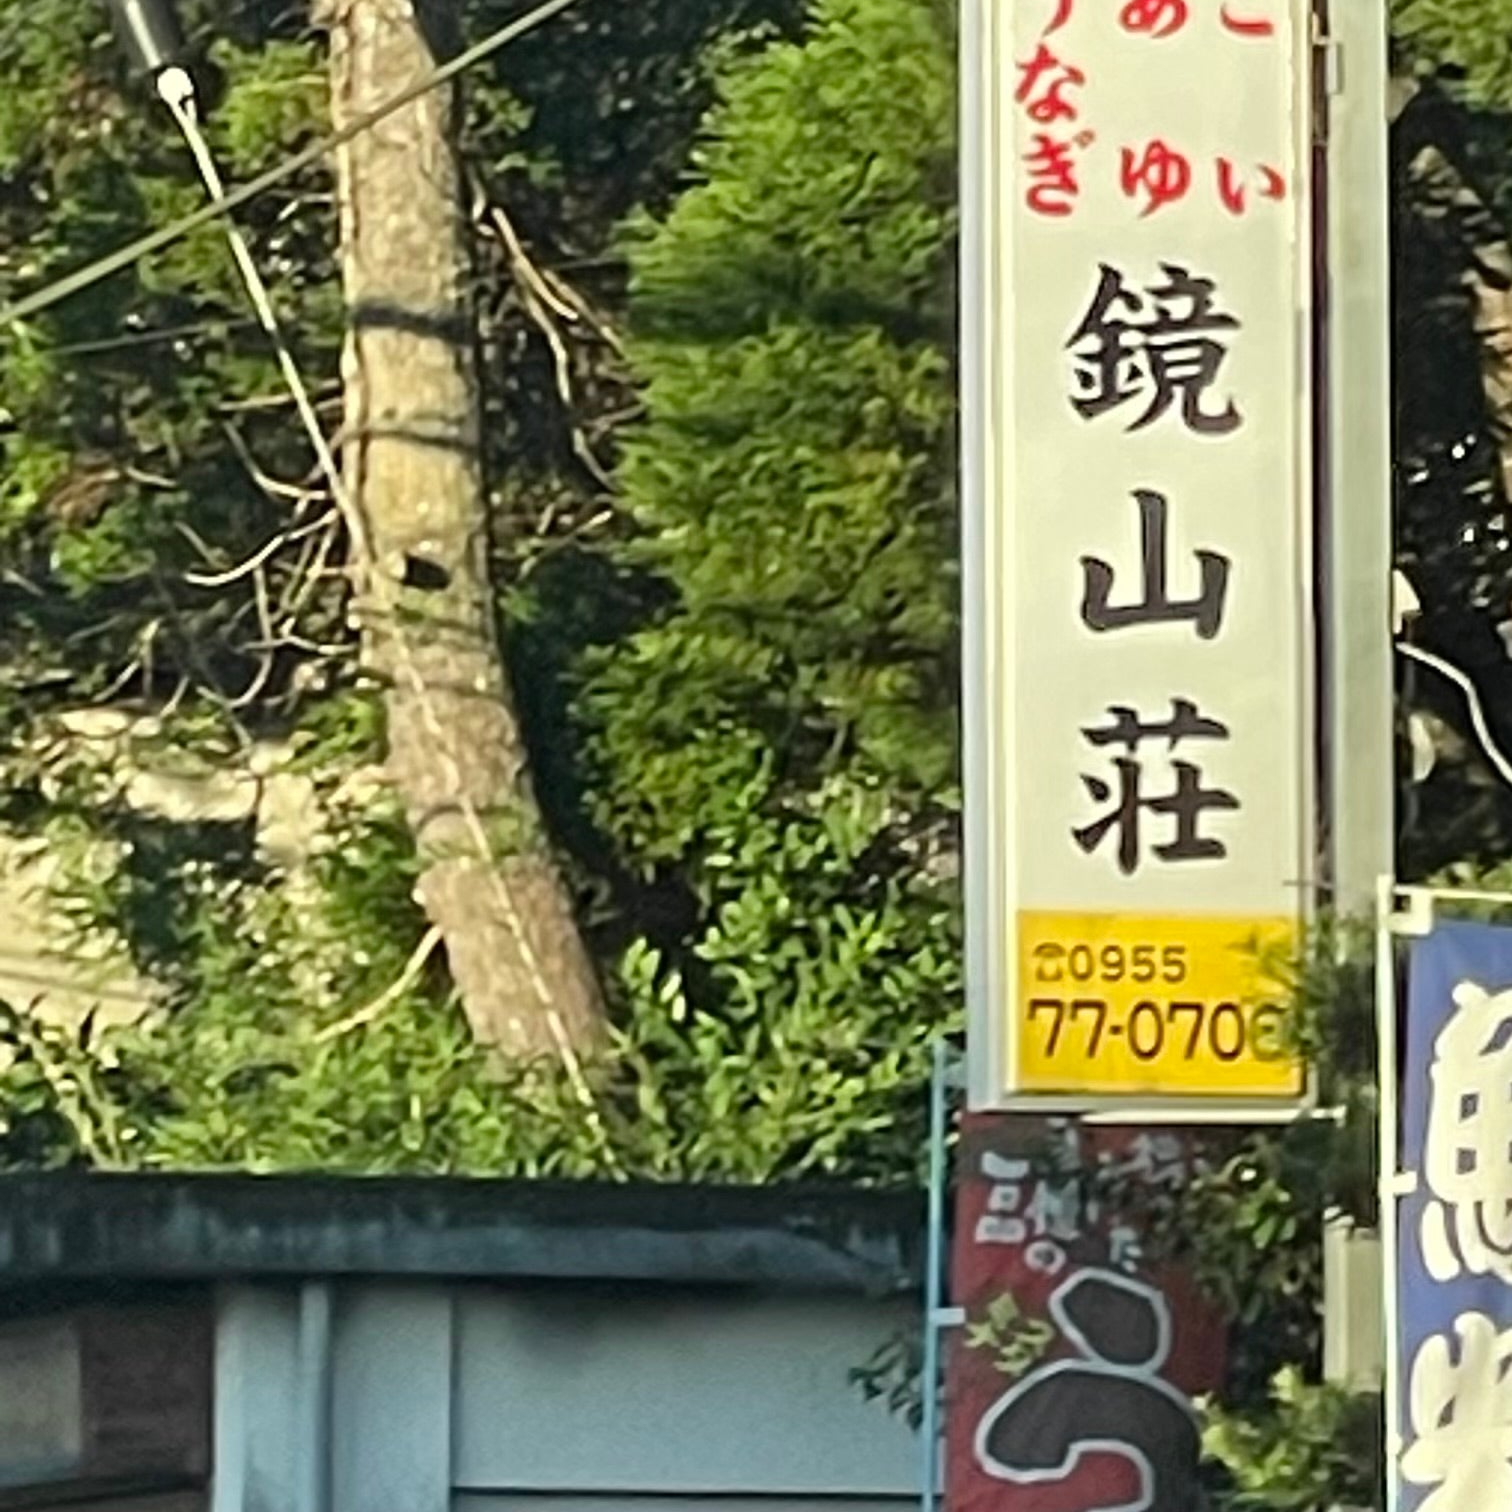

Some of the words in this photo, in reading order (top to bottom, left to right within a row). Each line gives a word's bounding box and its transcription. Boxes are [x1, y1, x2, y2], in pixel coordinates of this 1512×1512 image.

[1064, 262, 1246, 875] 鏡山荘
[1067, 944, 1187, 983] 0955
